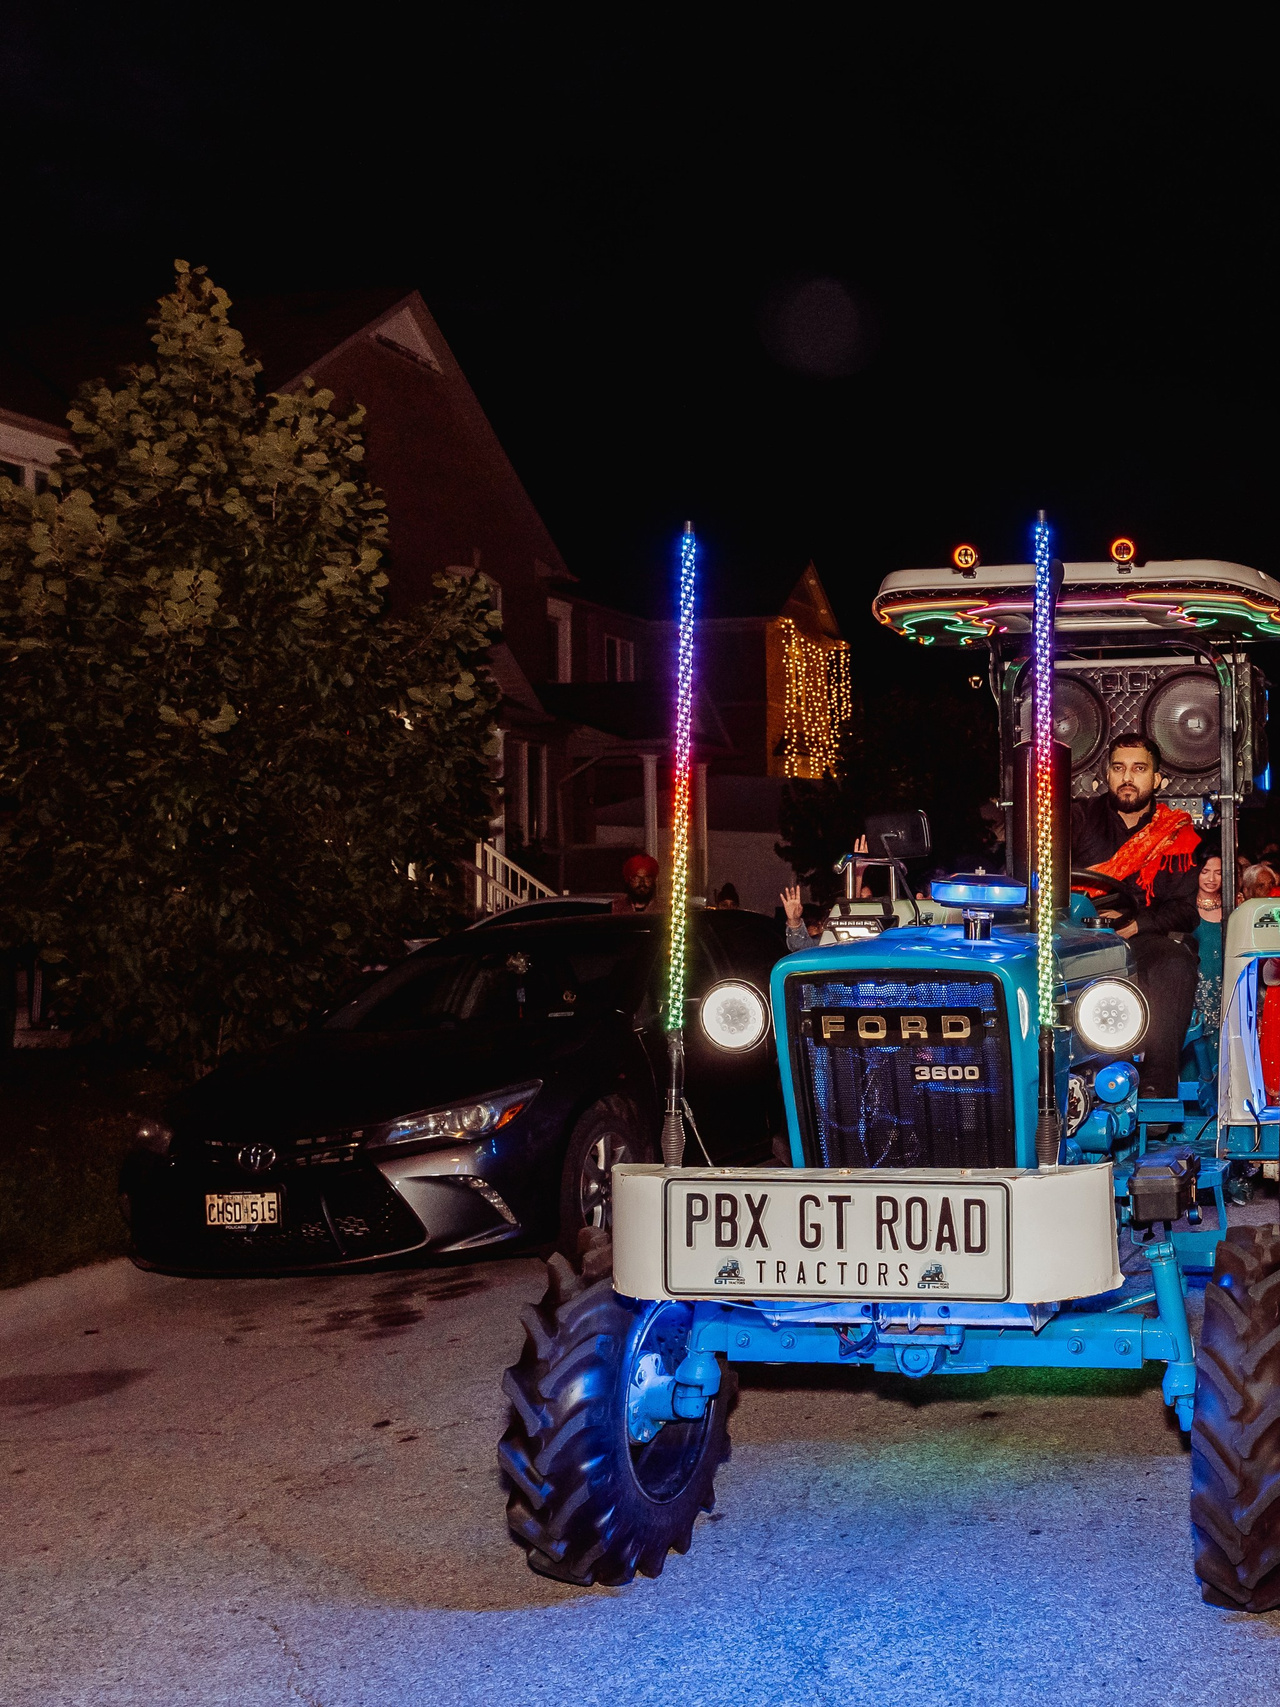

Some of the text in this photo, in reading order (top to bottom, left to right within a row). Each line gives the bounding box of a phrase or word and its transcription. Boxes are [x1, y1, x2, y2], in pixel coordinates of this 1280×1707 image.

[821, 1015, 971, 1039] FORD
[914, 1066, 980, 1080] 3600
[208, 1201, 276, 1223] CHSD 515
[686, 1192, 986, 1253] PBX GT ROAD
[756, 1260, 909, 1287] TRACTORS
